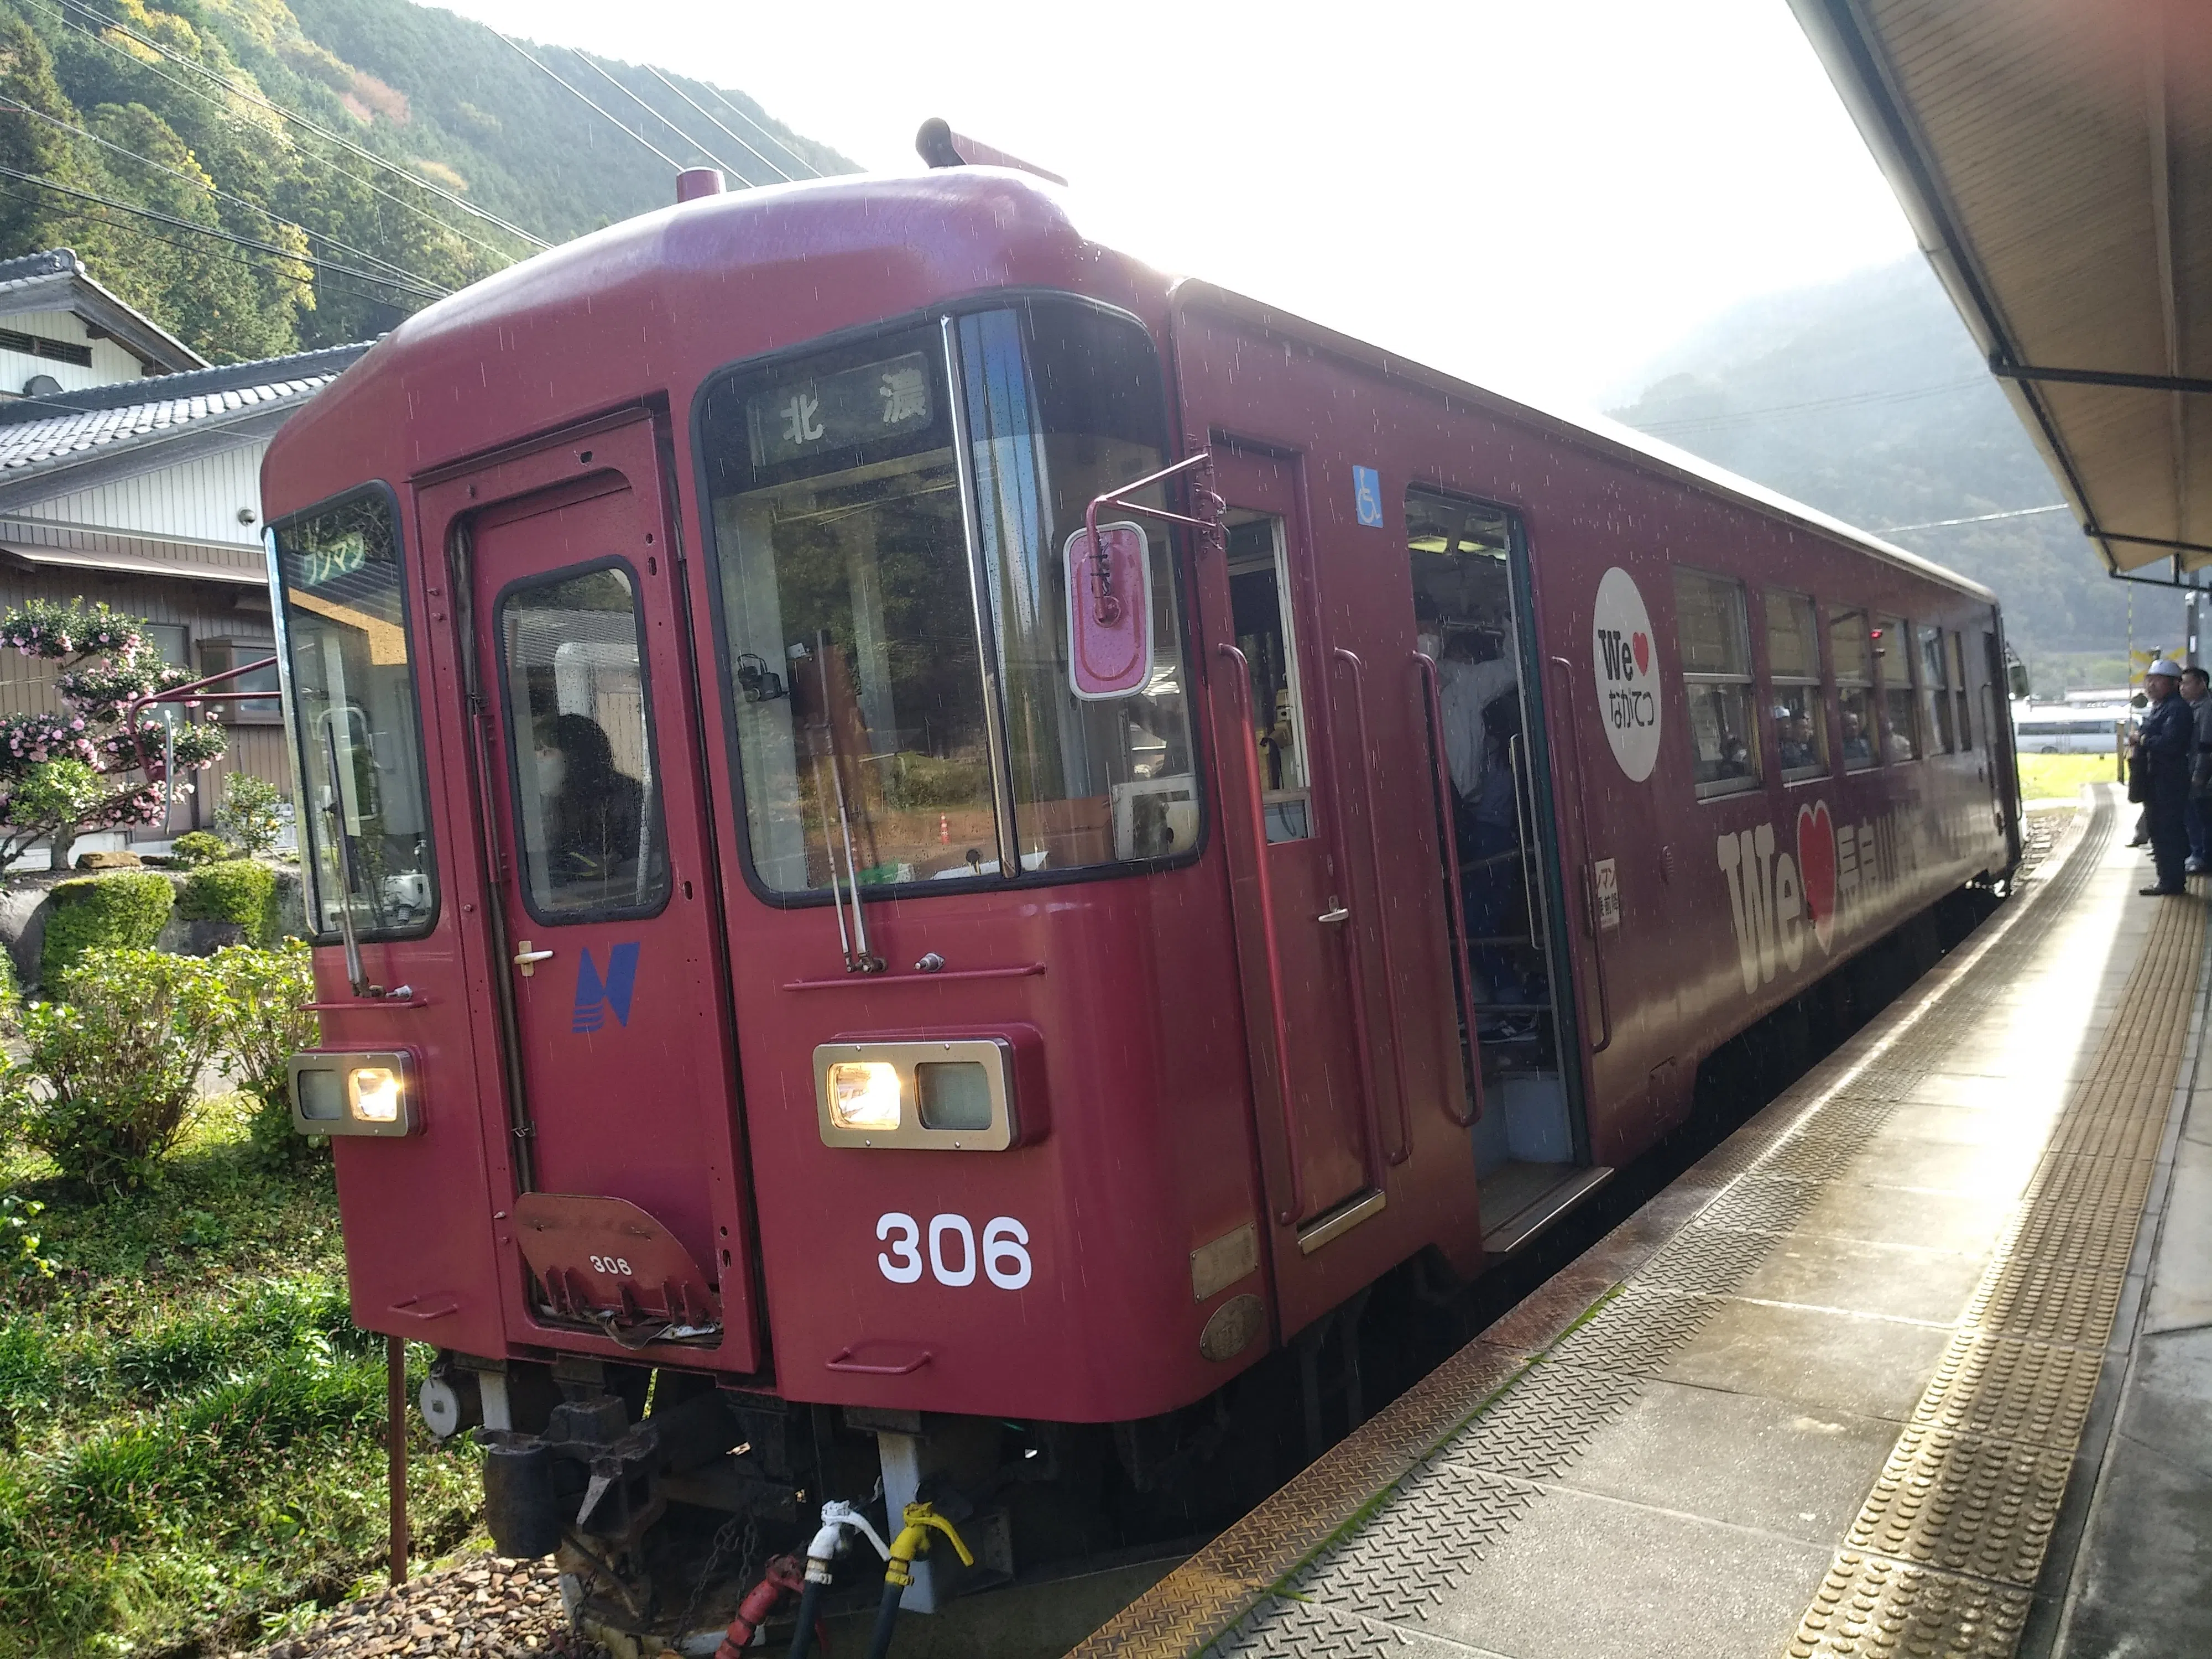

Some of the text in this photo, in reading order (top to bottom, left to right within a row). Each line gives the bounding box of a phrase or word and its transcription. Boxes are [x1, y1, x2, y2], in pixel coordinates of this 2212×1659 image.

[780, 368, 927, 445] 北濃
[304, 532, 364, 584] ワンマン
[1598, 629, 1634, 681] We
[1609, 687, 1655, 729] ながてつ
[1717, 822, 1804, 995] We
[589, 1255, 632, 1276] 306
[876, 1212, 1032, 1290] 306
